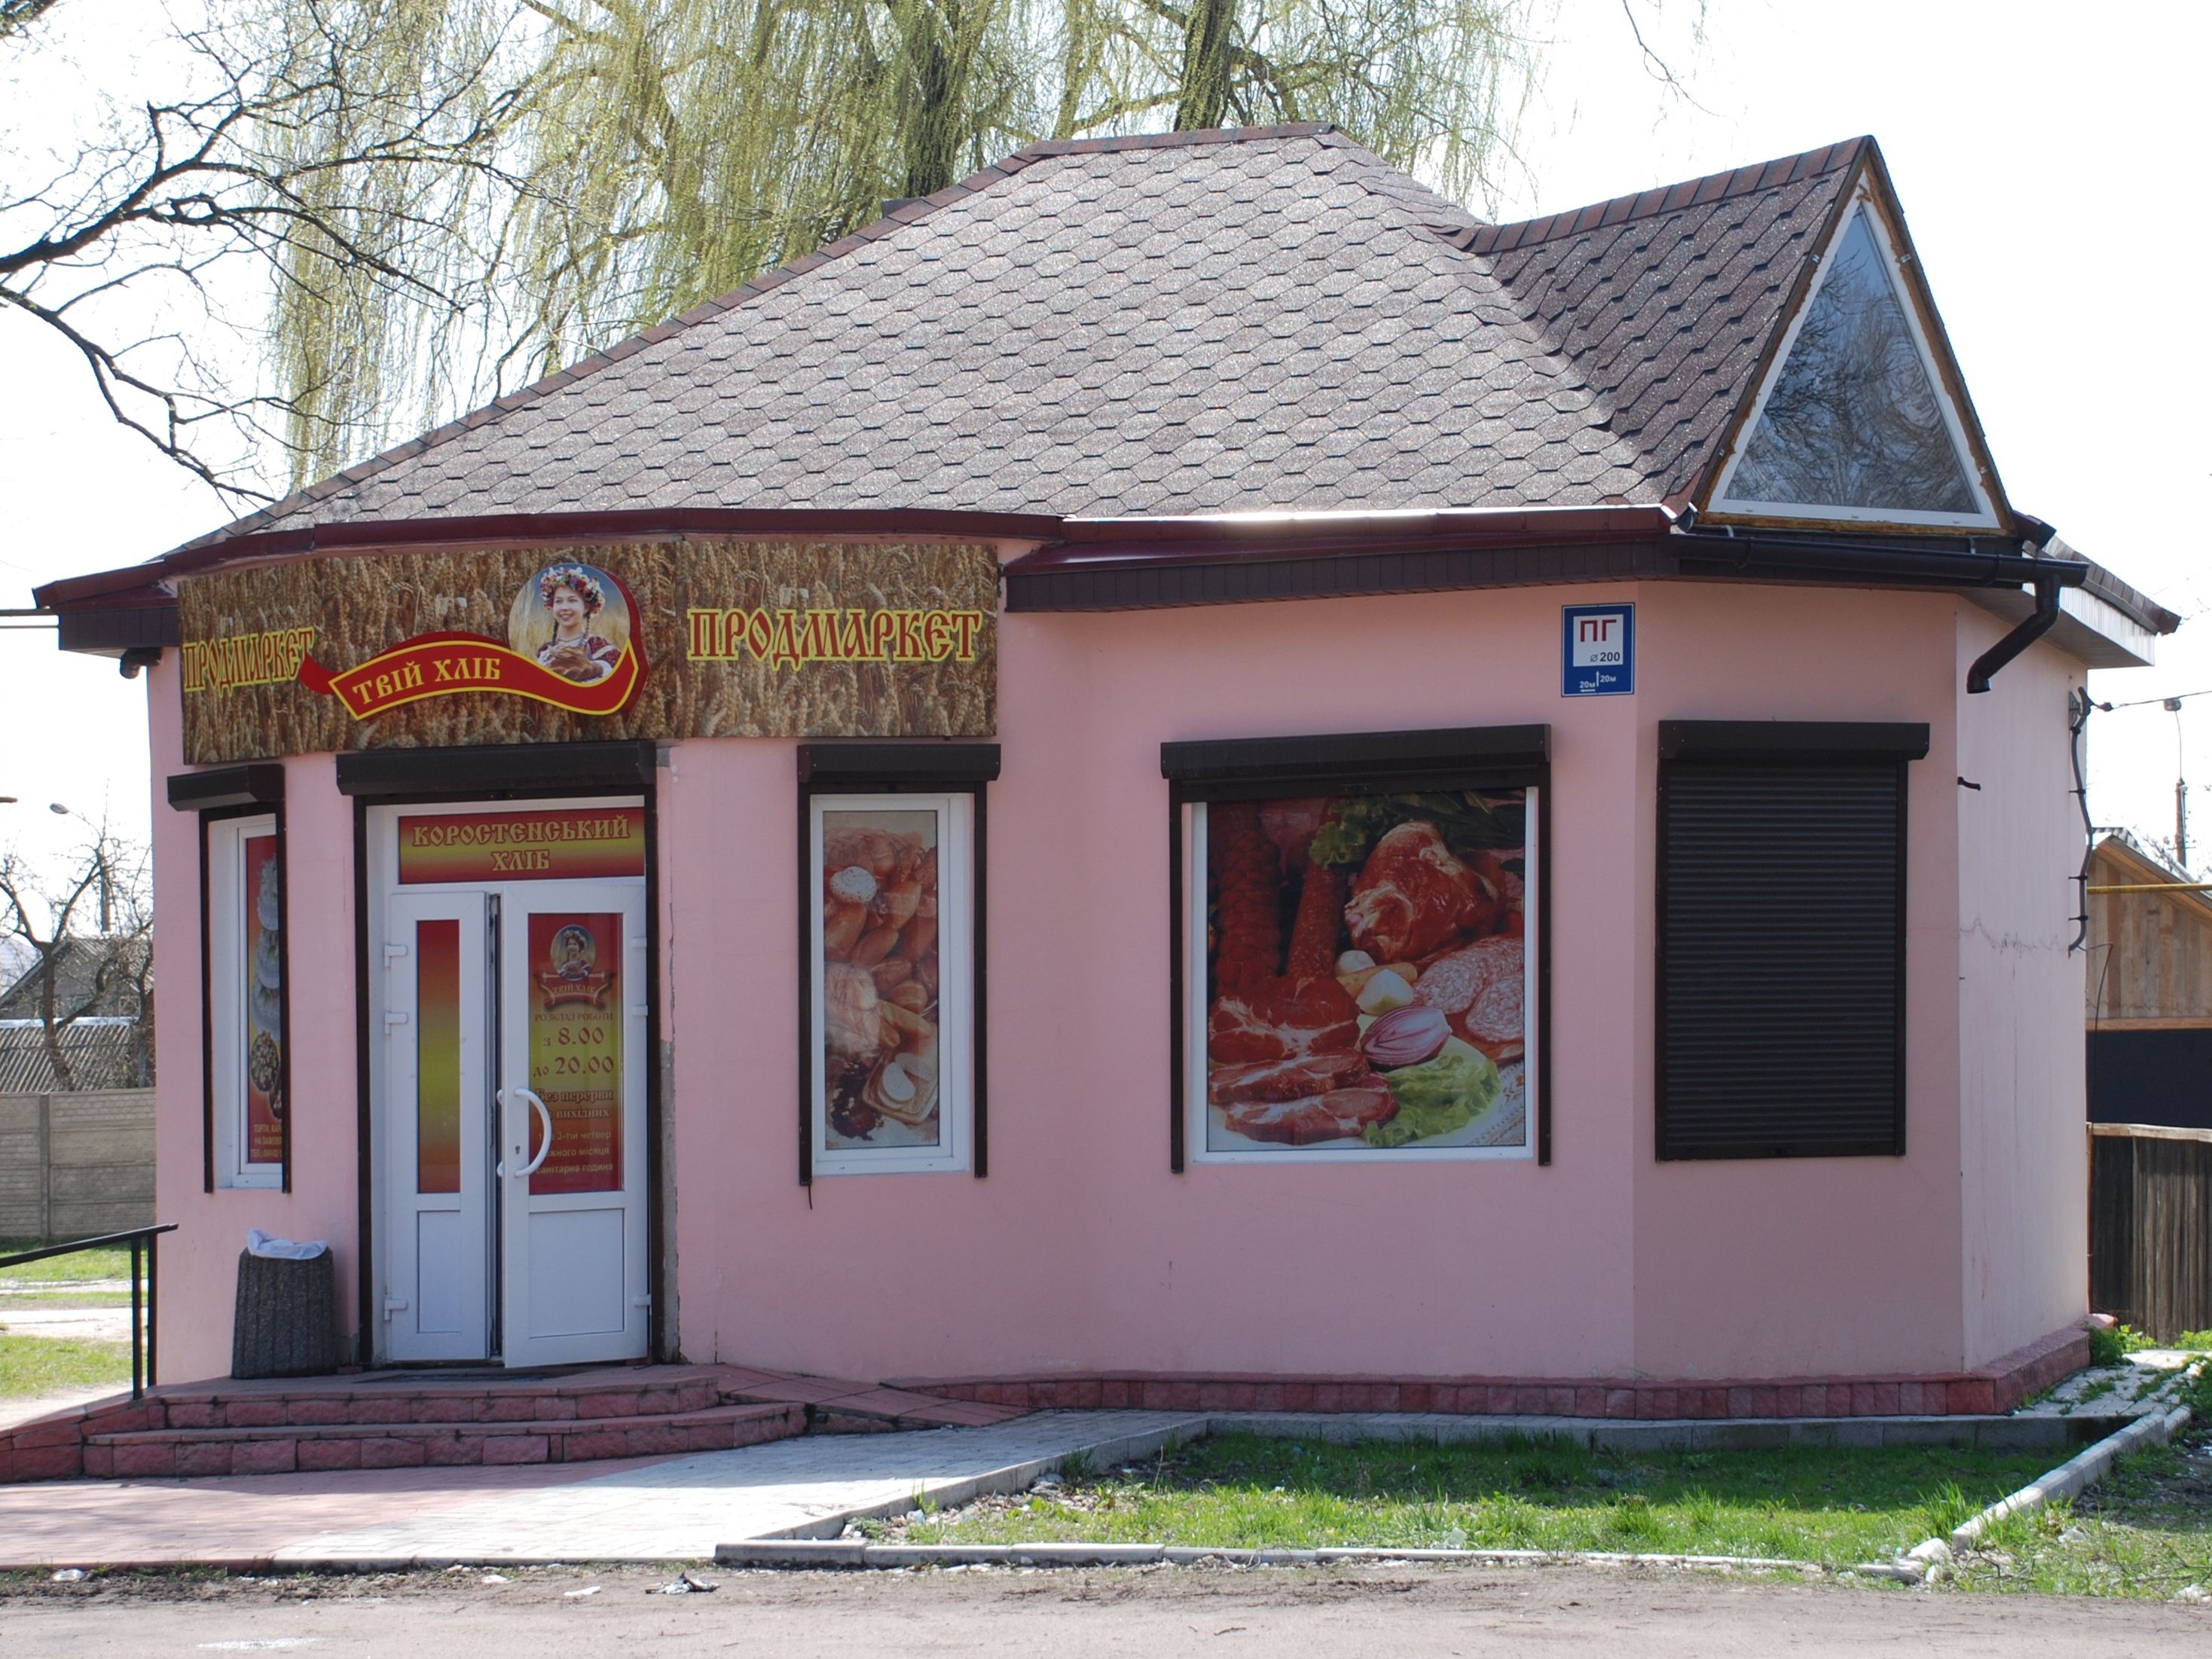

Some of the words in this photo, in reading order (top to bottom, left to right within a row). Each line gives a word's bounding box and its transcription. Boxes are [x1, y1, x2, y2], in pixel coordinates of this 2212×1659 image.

[687, 607, 982, 671] ПРОДМАРКЕТ
[1580, 619, 1618, 642] ПГ
[1599, 652, 1621, 662] 200
[353, 660, 424, 705] ТВІЙ
[434, 657, 501, 683] ХЛІБ
[412, 814, 631, 847] КОРОСТЕНСЬКИЙ
[492, 848, 551, 872] ХЛІБ
[558, 1027, 604, 1045] 8.00
[555, 1056, 614, 1074] 20.00
[561, 1089, 614, 1104] перерви
